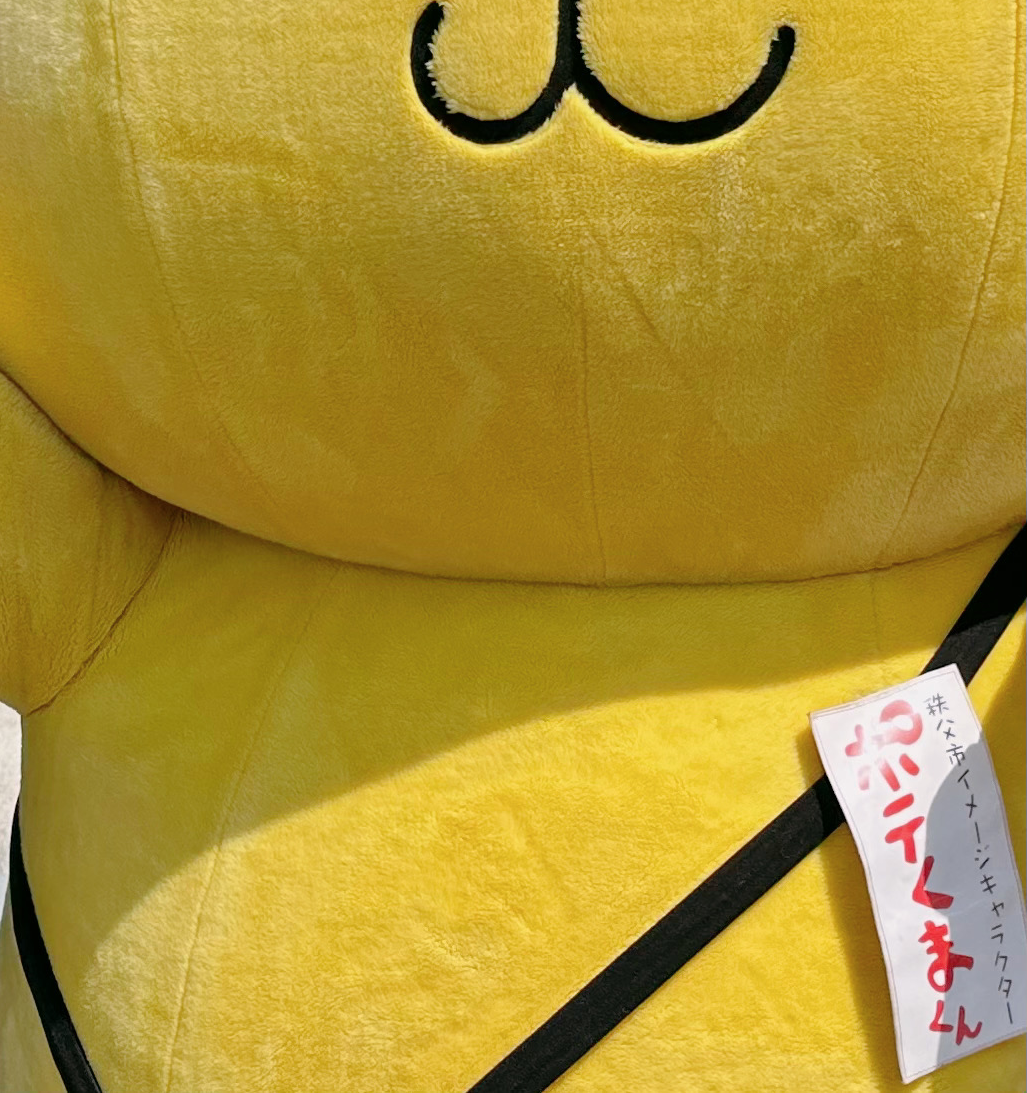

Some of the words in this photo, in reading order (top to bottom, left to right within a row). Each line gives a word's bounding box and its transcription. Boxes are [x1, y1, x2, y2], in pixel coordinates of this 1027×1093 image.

[925, 693, 1013, 1025] 秩父市イメージキャラクター
